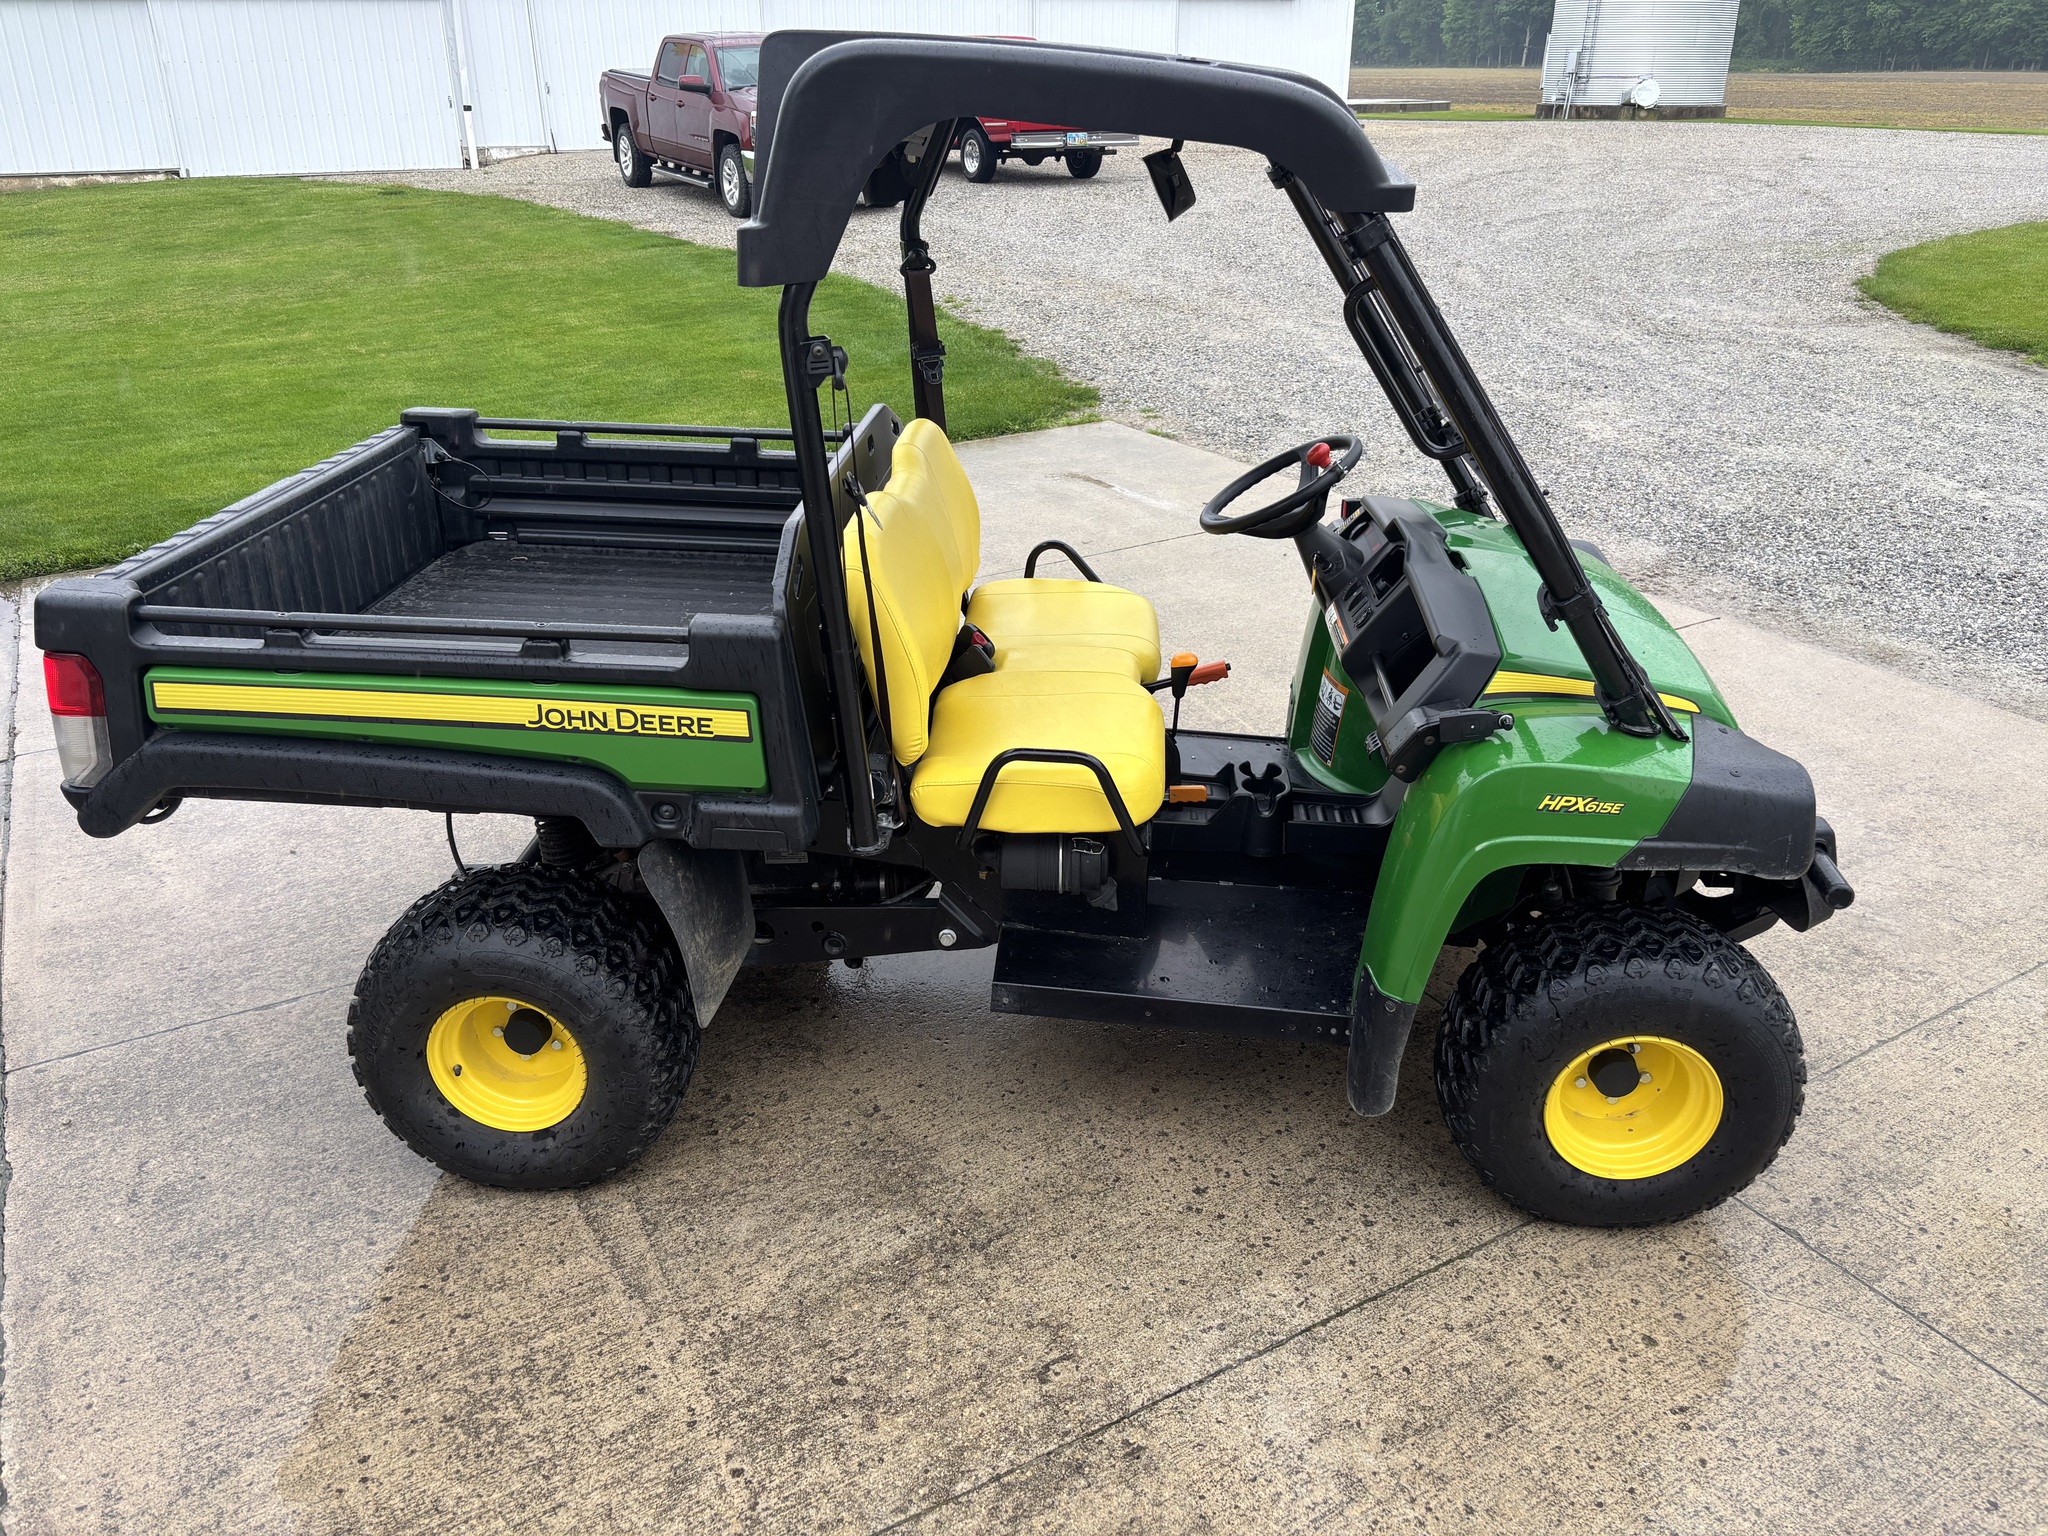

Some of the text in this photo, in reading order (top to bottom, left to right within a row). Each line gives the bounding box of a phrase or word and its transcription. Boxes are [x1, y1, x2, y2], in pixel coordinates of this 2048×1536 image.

[528, 703, 714, 735] JOHN DEERE
[1537, 794, 1626, 815] HPX615E
